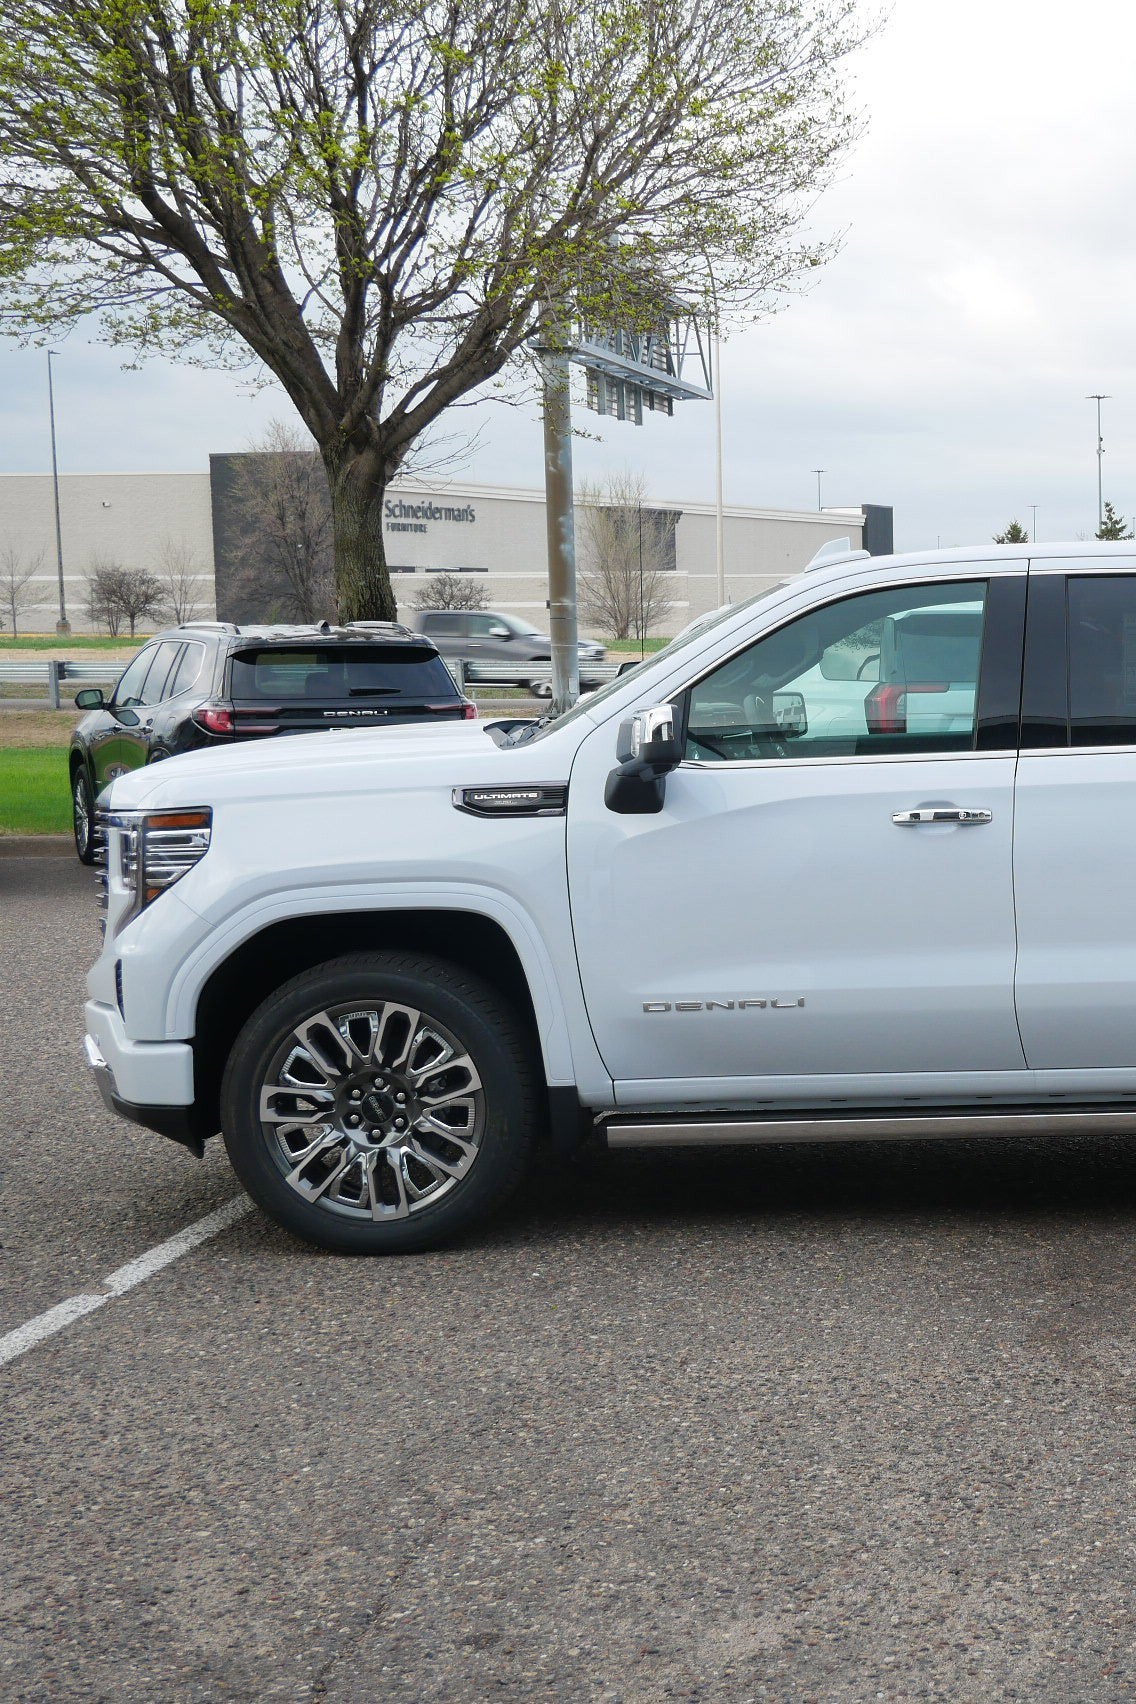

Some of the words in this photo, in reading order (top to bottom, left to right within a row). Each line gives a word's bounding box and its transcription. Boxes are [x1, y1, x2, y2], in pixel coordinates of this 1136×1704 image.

[385, 499, 476, 523] Schneiderman's
[386, 522, 428, 533] FURNITURE
[474, 792, 538, 800] ULTIMATE
[642, 996, 805, 1013] DENALI
